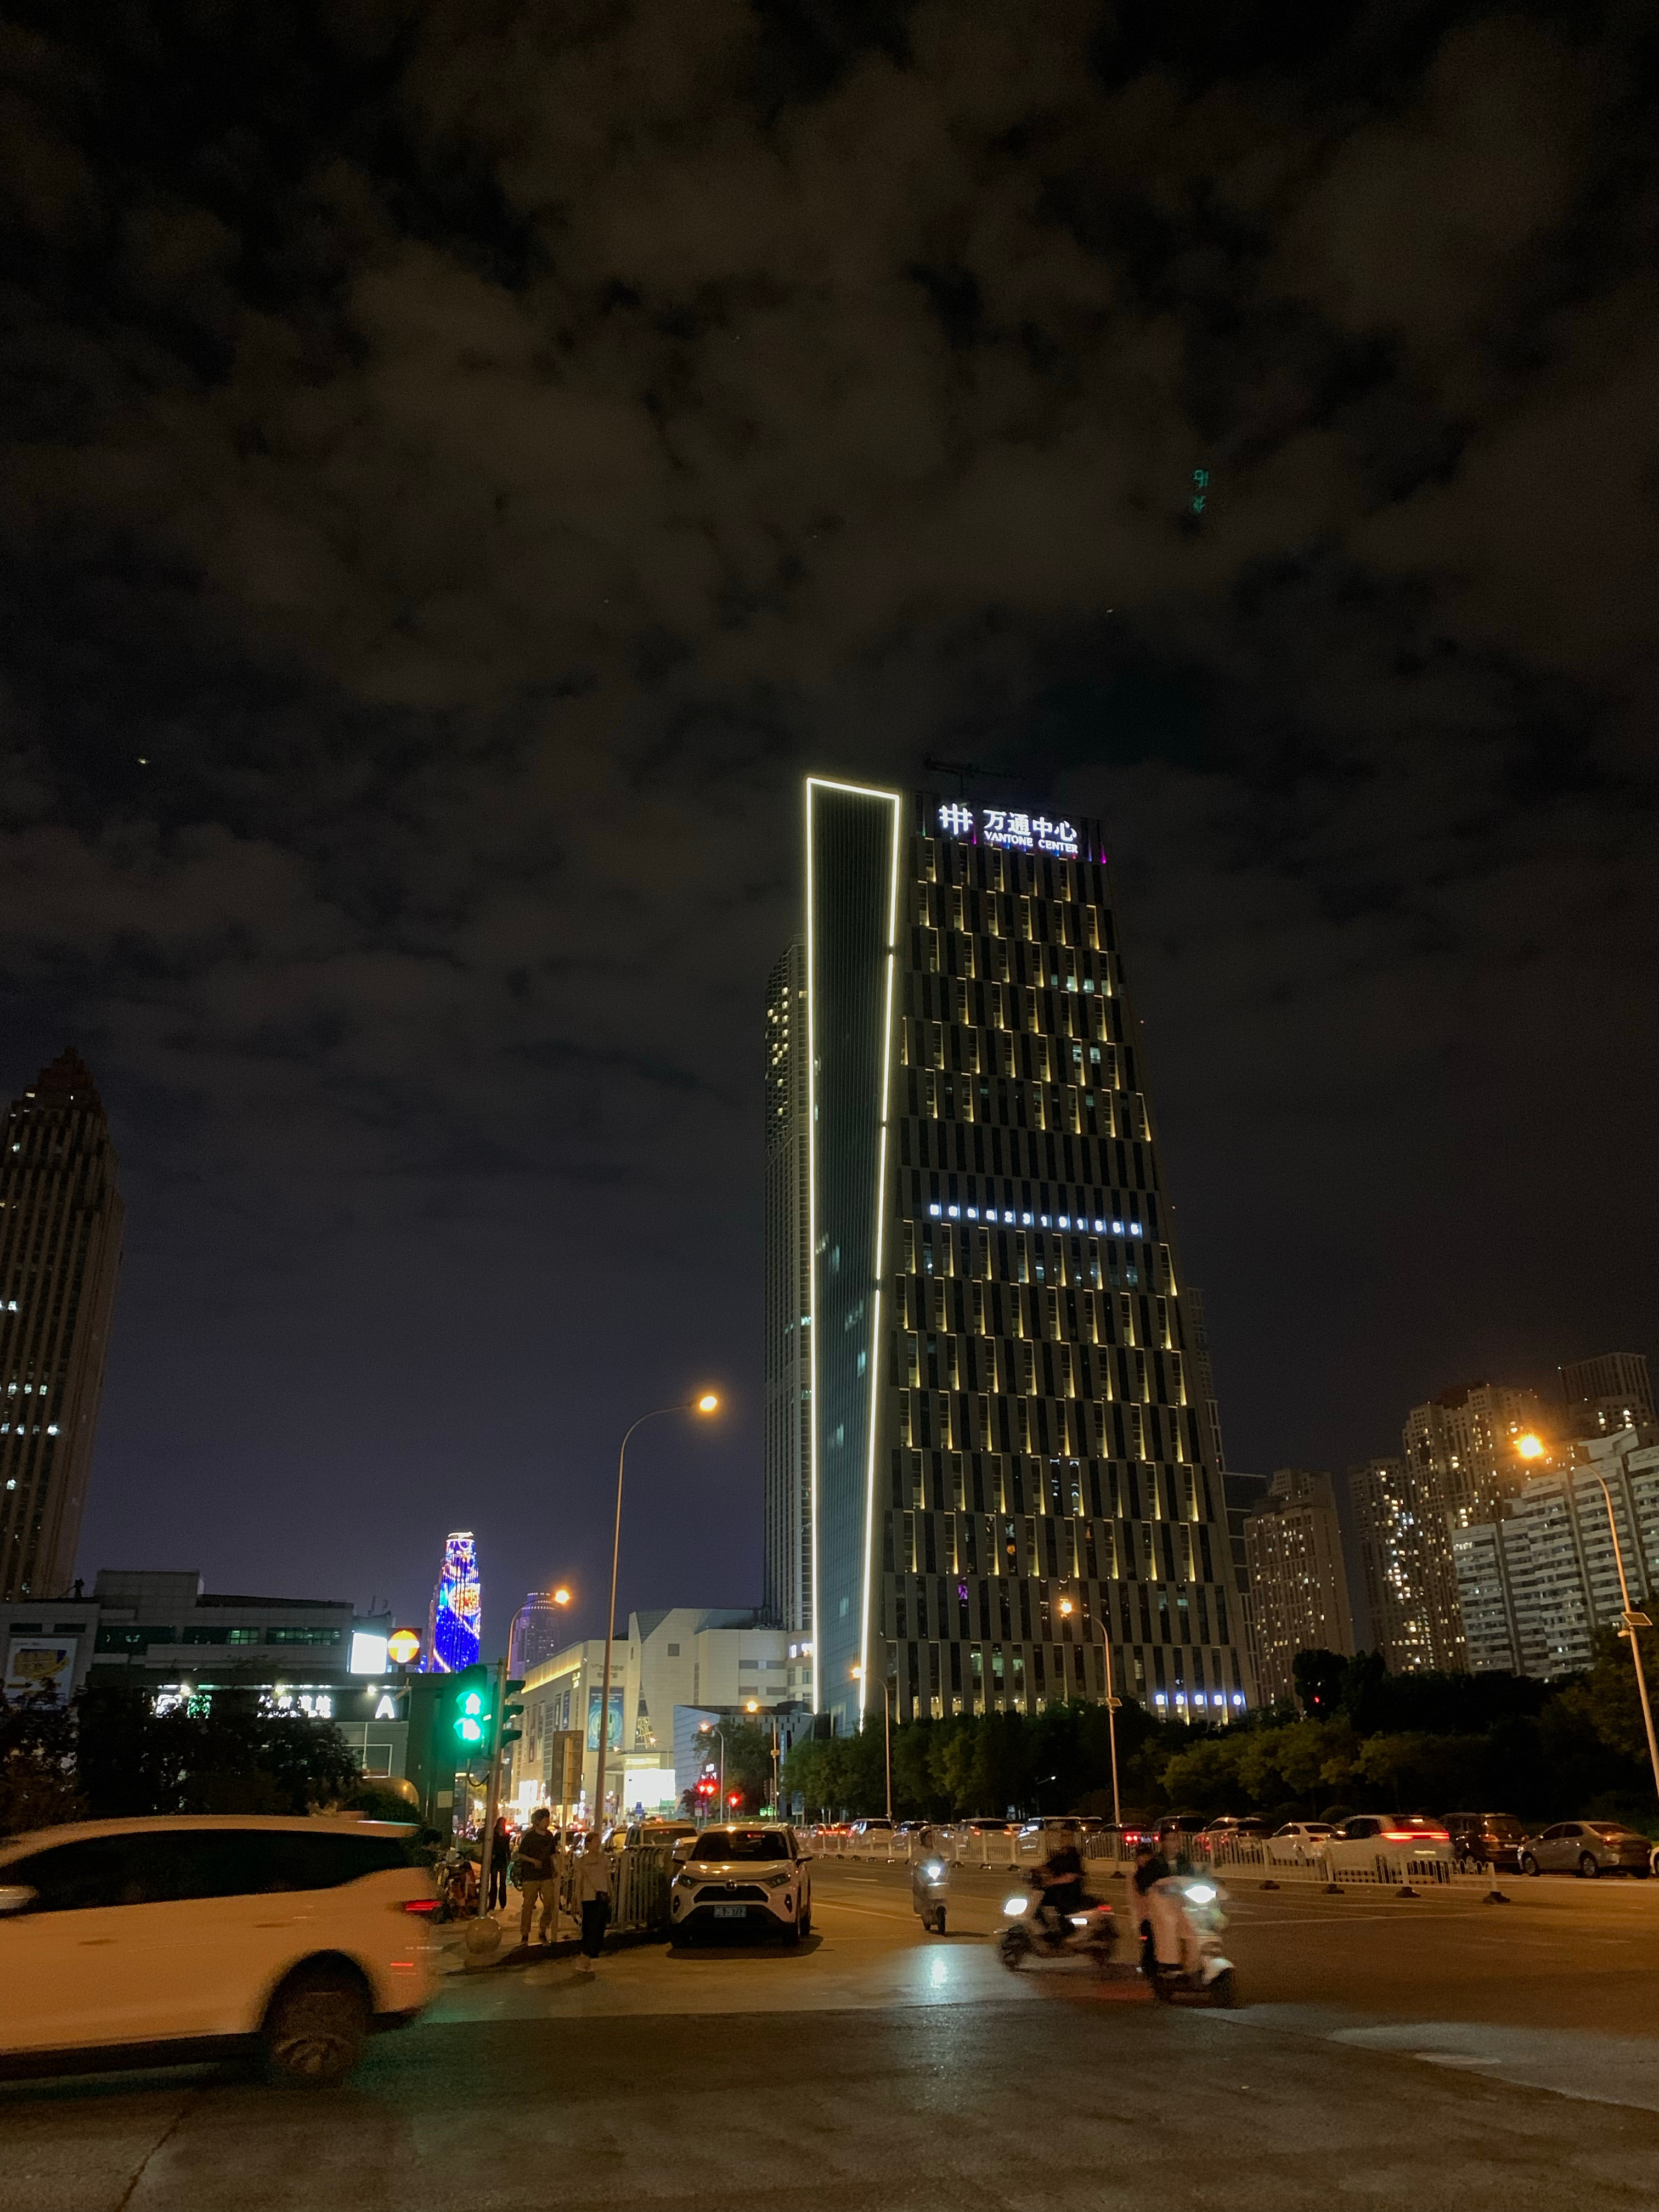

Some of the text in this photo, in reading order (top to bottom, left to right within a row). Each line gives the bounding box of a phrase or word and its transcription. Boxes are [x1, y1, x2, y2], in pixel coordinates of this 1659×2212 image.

[983, 809, 1078, 842] 万通中心
[984, 831, 1079, 854] VANTONE CENTER
